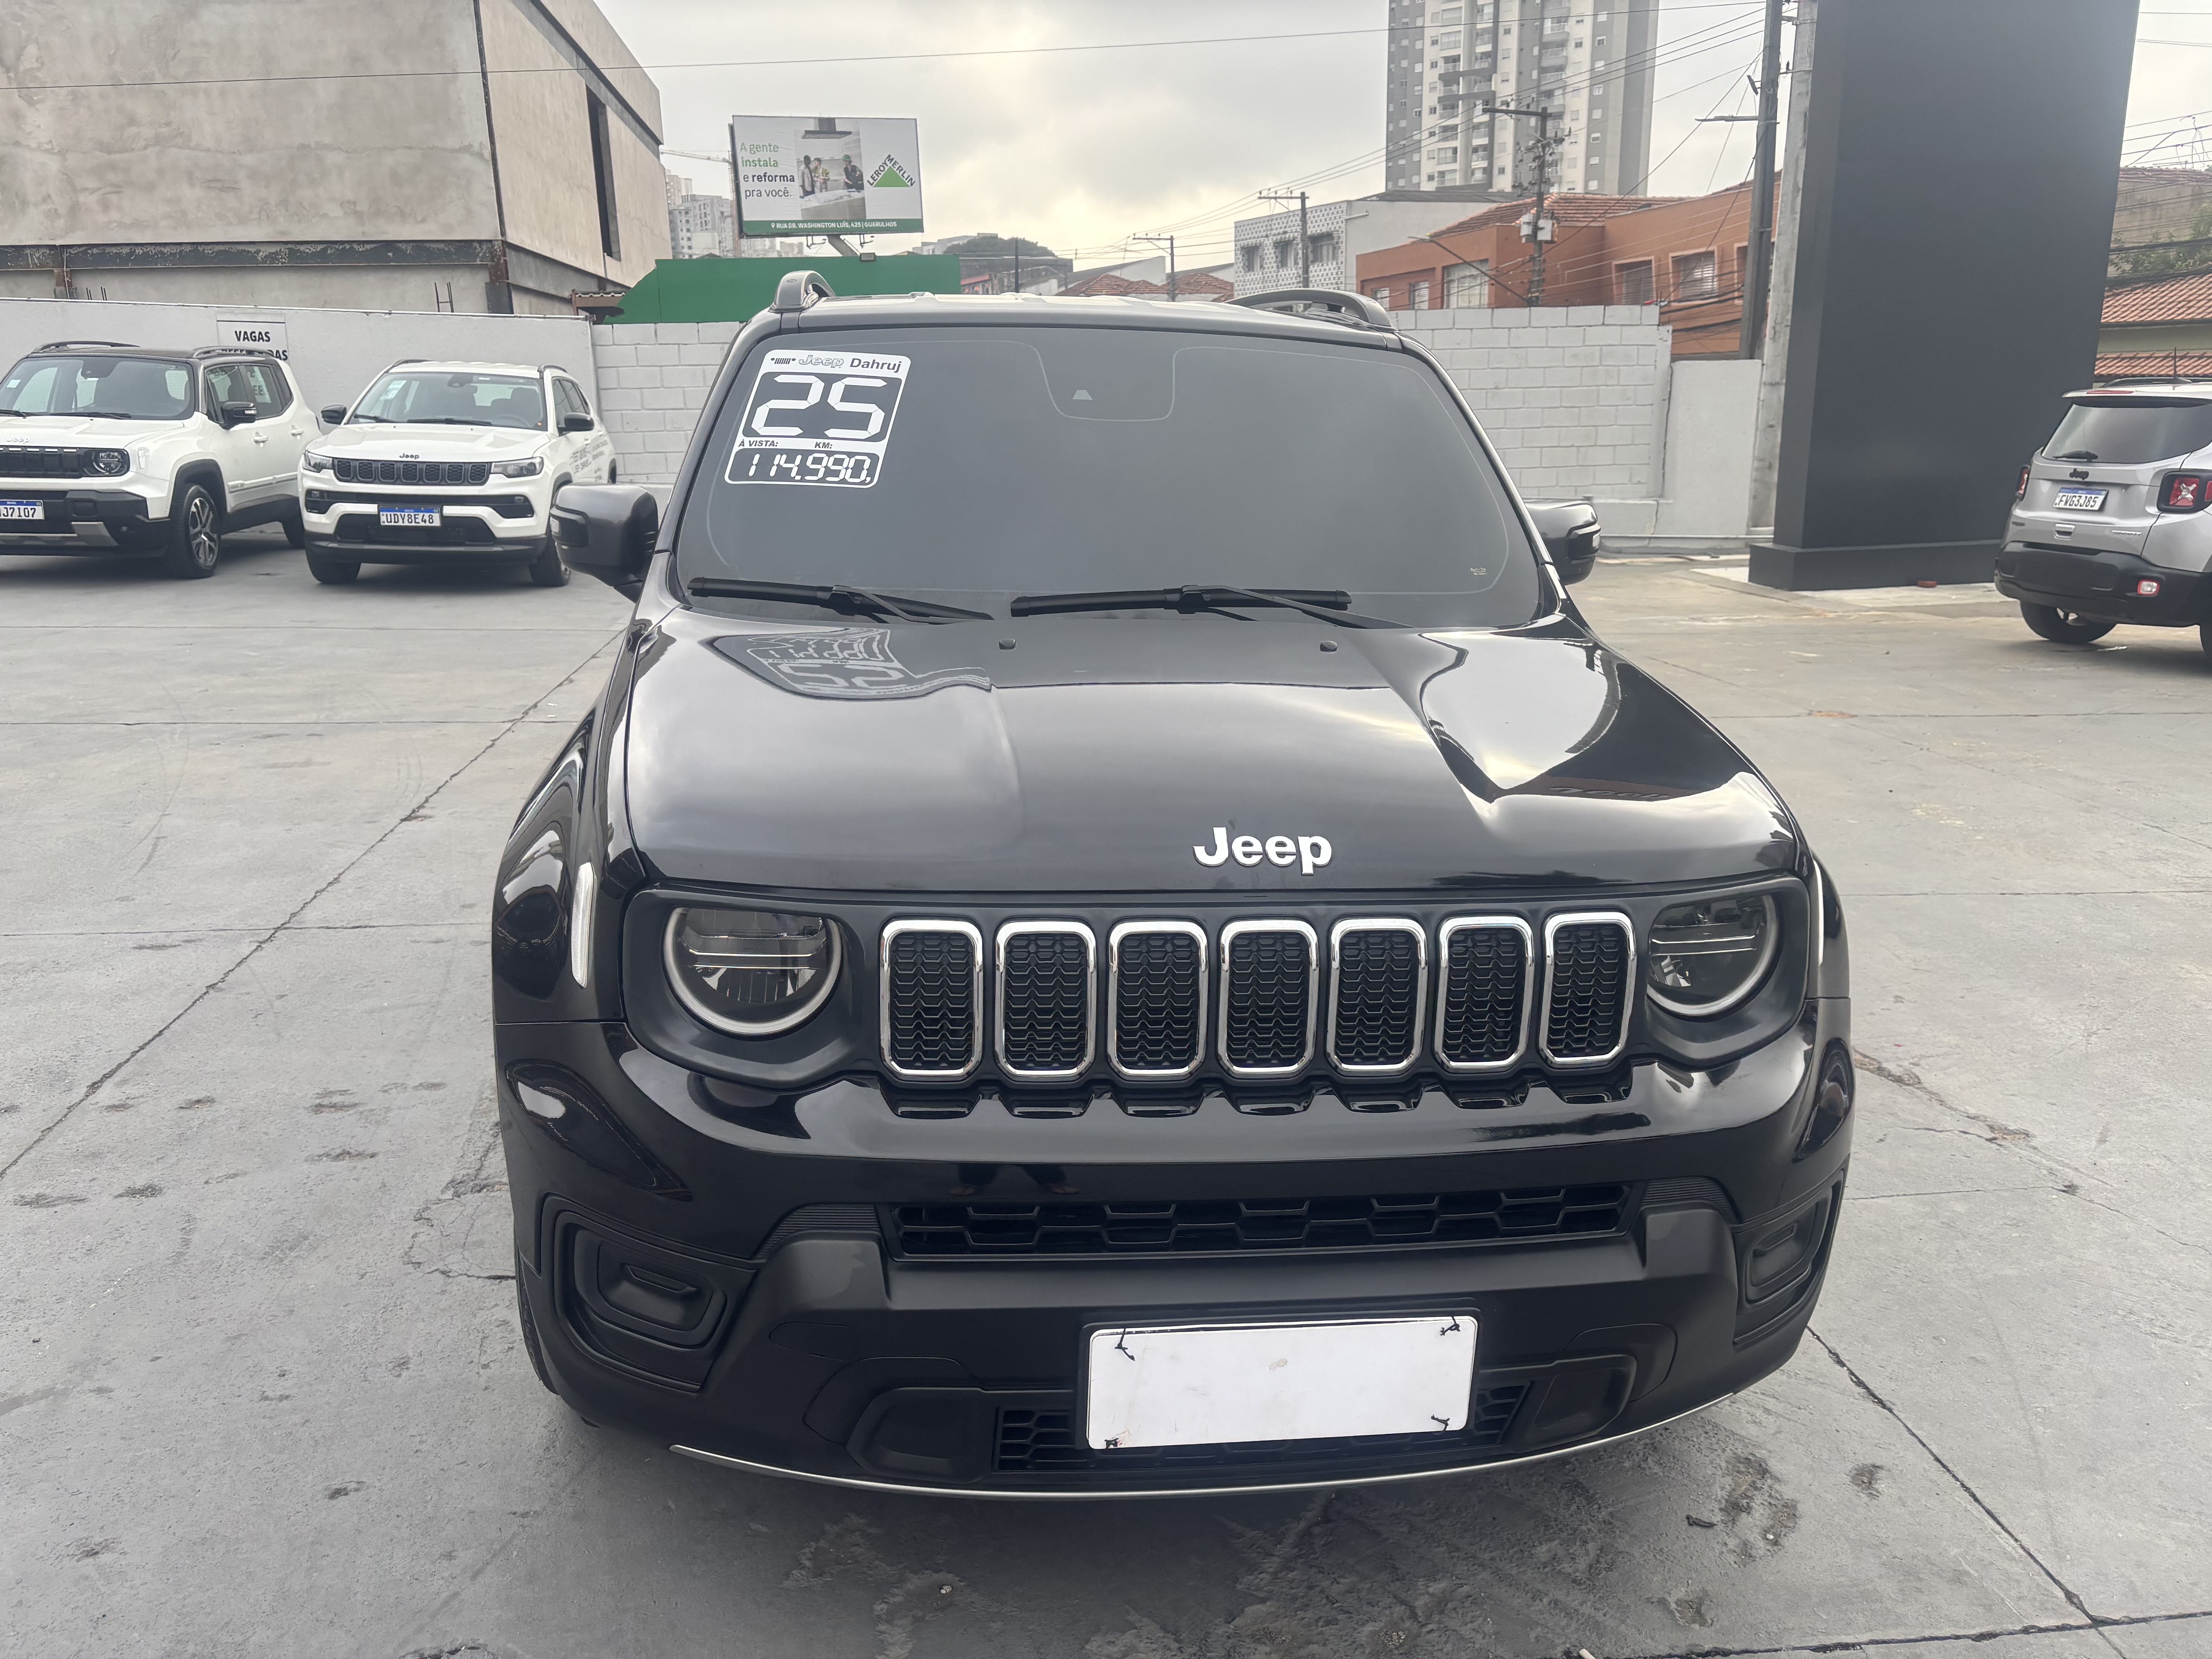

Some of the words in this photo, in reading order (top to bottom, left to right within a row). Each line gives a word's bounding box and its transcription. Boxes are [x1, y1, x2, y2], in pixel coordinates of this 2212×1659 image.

[740, 143, 747, 151] A
[749, 143, 779, 154] gente
[741, 157, 778, 167] instala
[867, 159, 888, 186] LEROY
[886, 154, 915, 186] MERLIN
[752, 172, 795, 182] reforma
[745, 189, 762, 199] pra
[764, 187, 792, 197] você.
[235, 330, 271, 342] VAGAS
[799, 355, 844, 368] Jeep
[850, 358, 902, 373] Dahruj
[751, 374, 887, 439] 25
[386, 513, 434, 524] UDY8E48
[1193, 827, 1332, 876] Jeep
